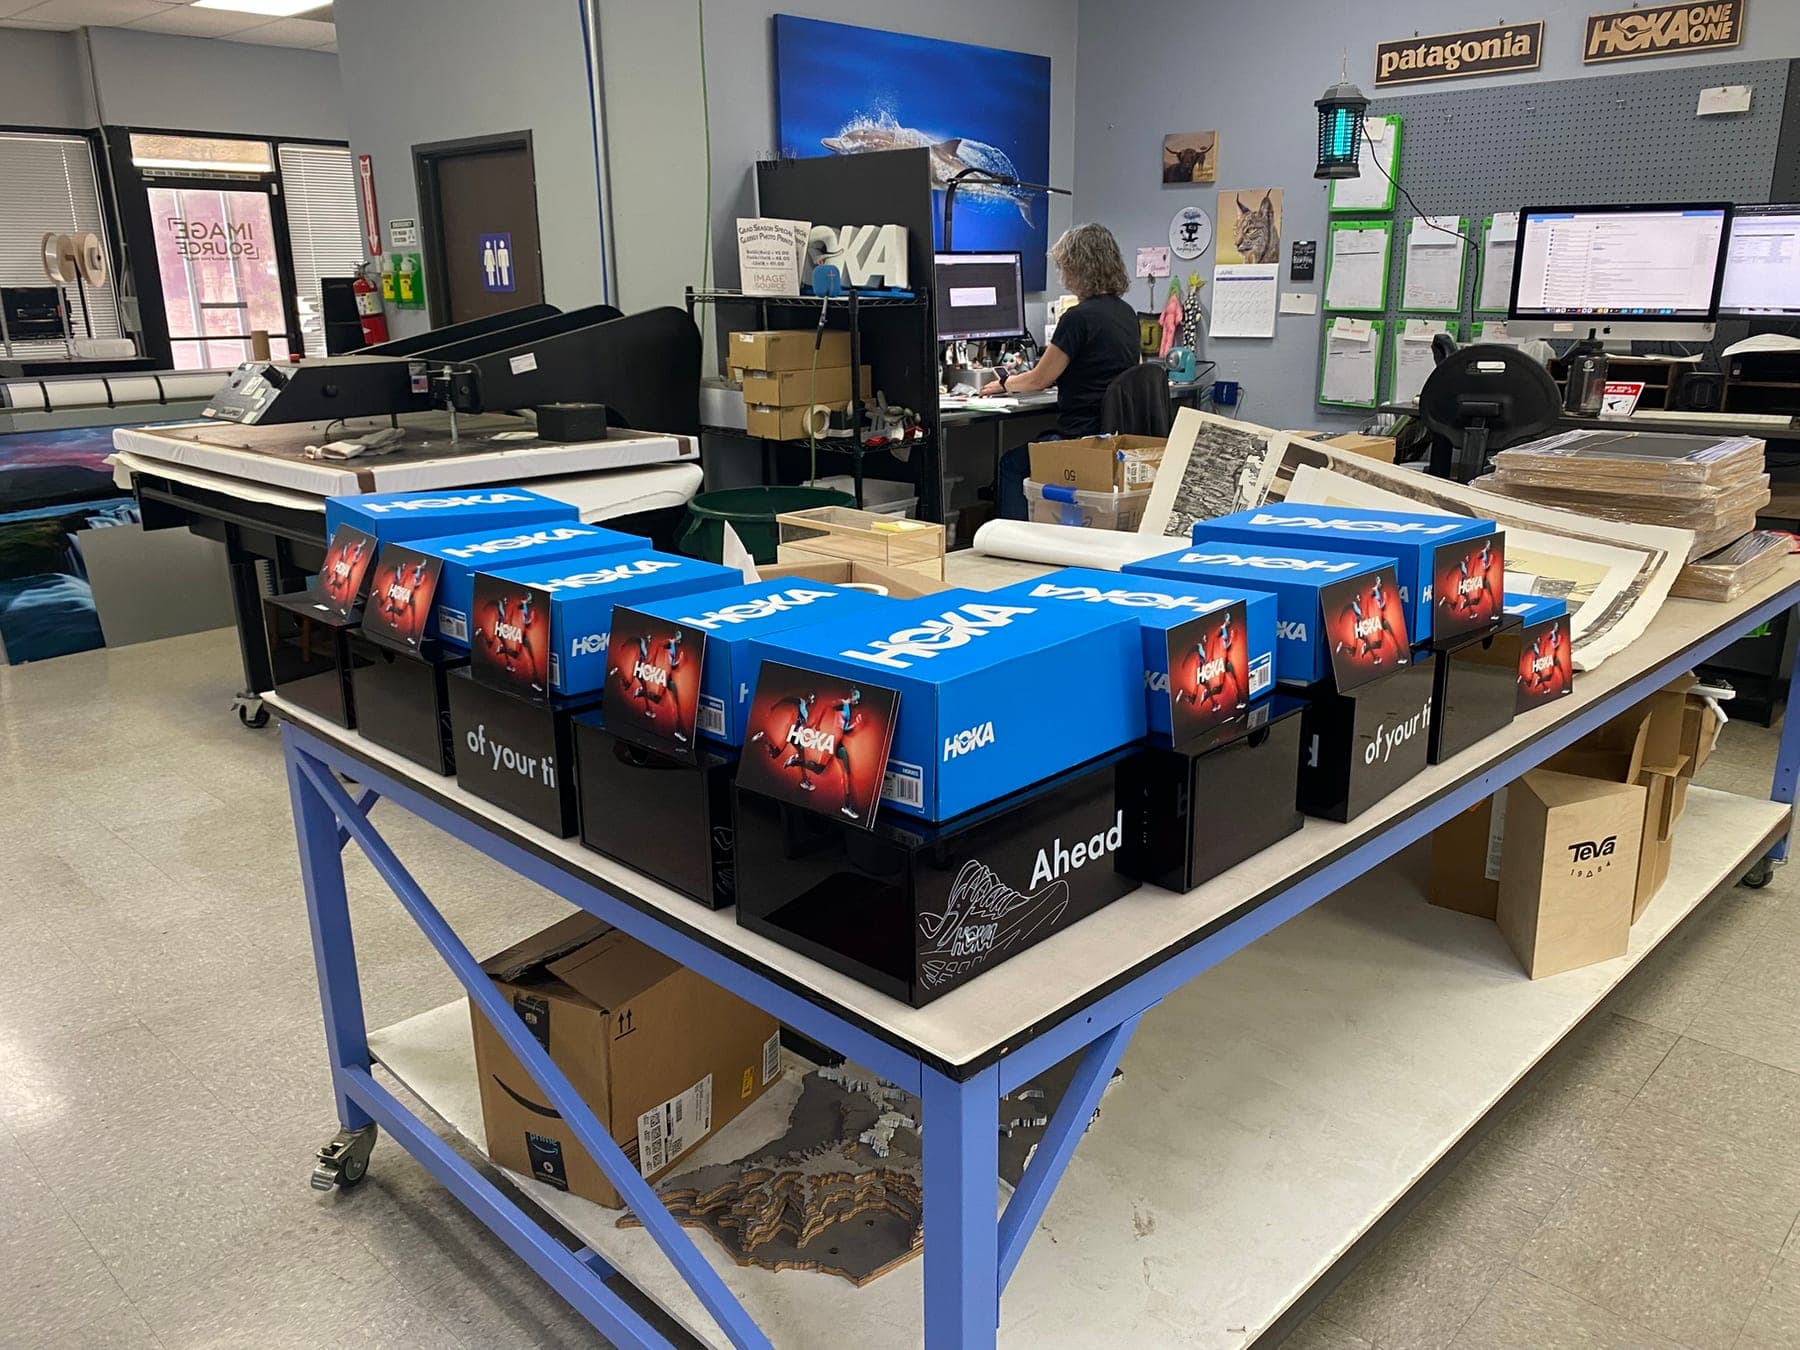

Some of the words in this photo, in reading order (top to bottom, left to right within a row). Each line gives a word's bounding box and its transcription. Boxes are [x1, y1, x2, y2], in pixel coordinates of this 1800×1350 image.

[1588, 9, 1689, 56] HOKA
[1688, 3, 1733, 26] ONE
[1688, 21, 1734, 43] ONE
[1379, 31, 1531, 78] patagonia
[753, 274, 785, 283] IMAGE
[362, 493, 535, 513] HOKA
[1247, 513, 1463, 534] HOKA
[440, 527, 598, 558] HOKA
[523, 559, 682, 592] HOKA
[1178, 553, 1360, 573] HOKA
[387, 583, 412, 603] HOKA
[1029, 583, 1237, 612] HOKA
[1458, 576, 1484, 595] HOKA
[676, 589, 839, 629] HOKA
[494, 621, 523, 644] HOKA
[838, 603, 1039, 669] HOKA
[1354, 616, 1382, 639] HOKA
[632, 660, 668, 688] HOKA
[1196, 656, 1226, 685] HOKA
[1531, 654, 1555, 673] HOKA
[466, 724, 486, 756] of
[489, 740, 537, 778] your
[786, 724, 836, 755] HOKA
[943, 721, 995, 762] HOKA
[1365, 724, 1384, 765] of
[1383, 712, 1421, 763] your
[1029, 809, 1123, 891] Ahead
[950, 922, 998, 956] HOKA
